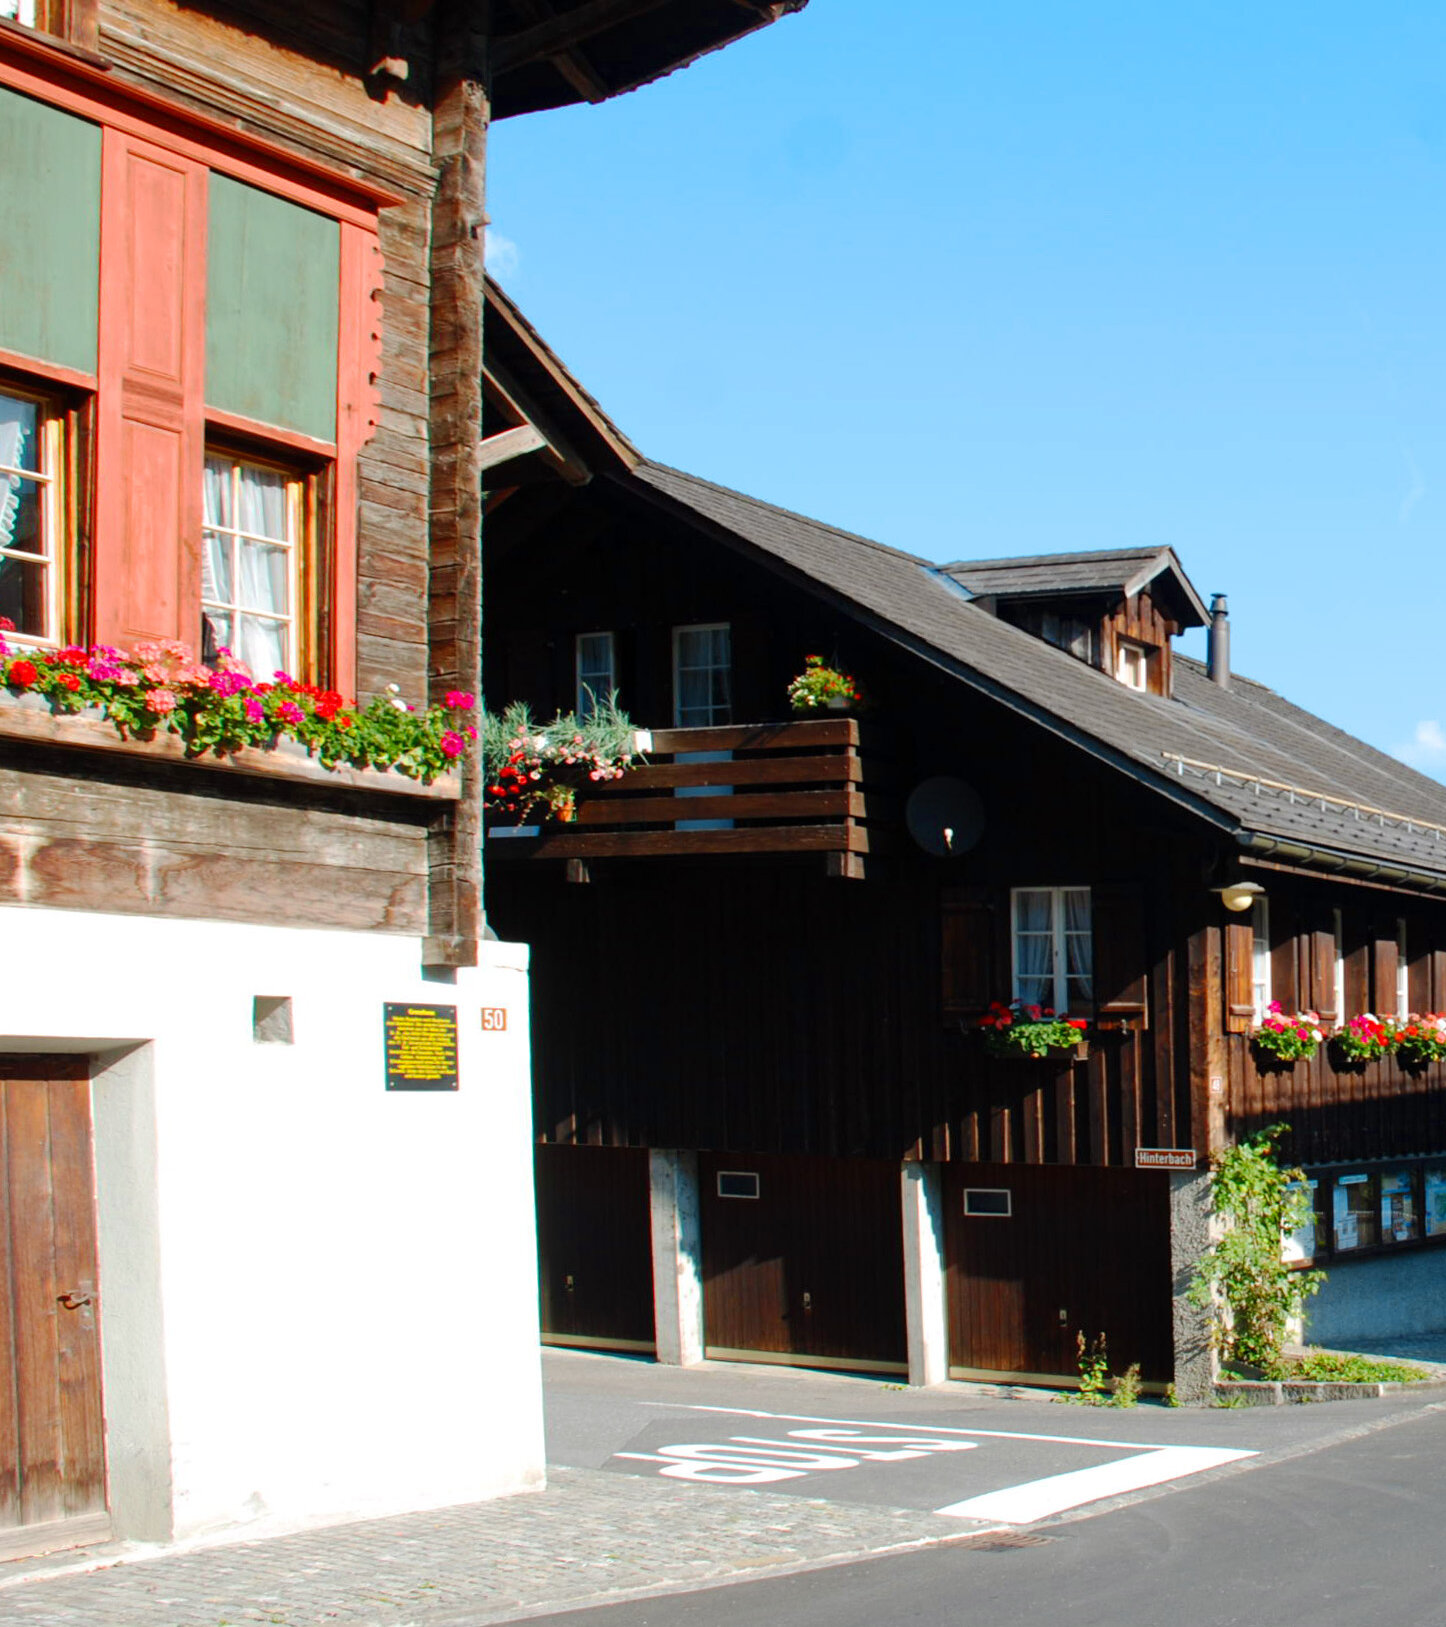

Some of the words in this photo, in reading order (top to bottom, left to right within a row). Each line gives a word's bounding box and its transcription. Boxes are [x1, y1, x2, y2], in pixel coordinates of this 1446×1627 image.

[483, 1009, 504, 1030] 50
[1139, 1151, 1192, 1165] Hinterbach
[613, 1426, 980, 1485] STOP
